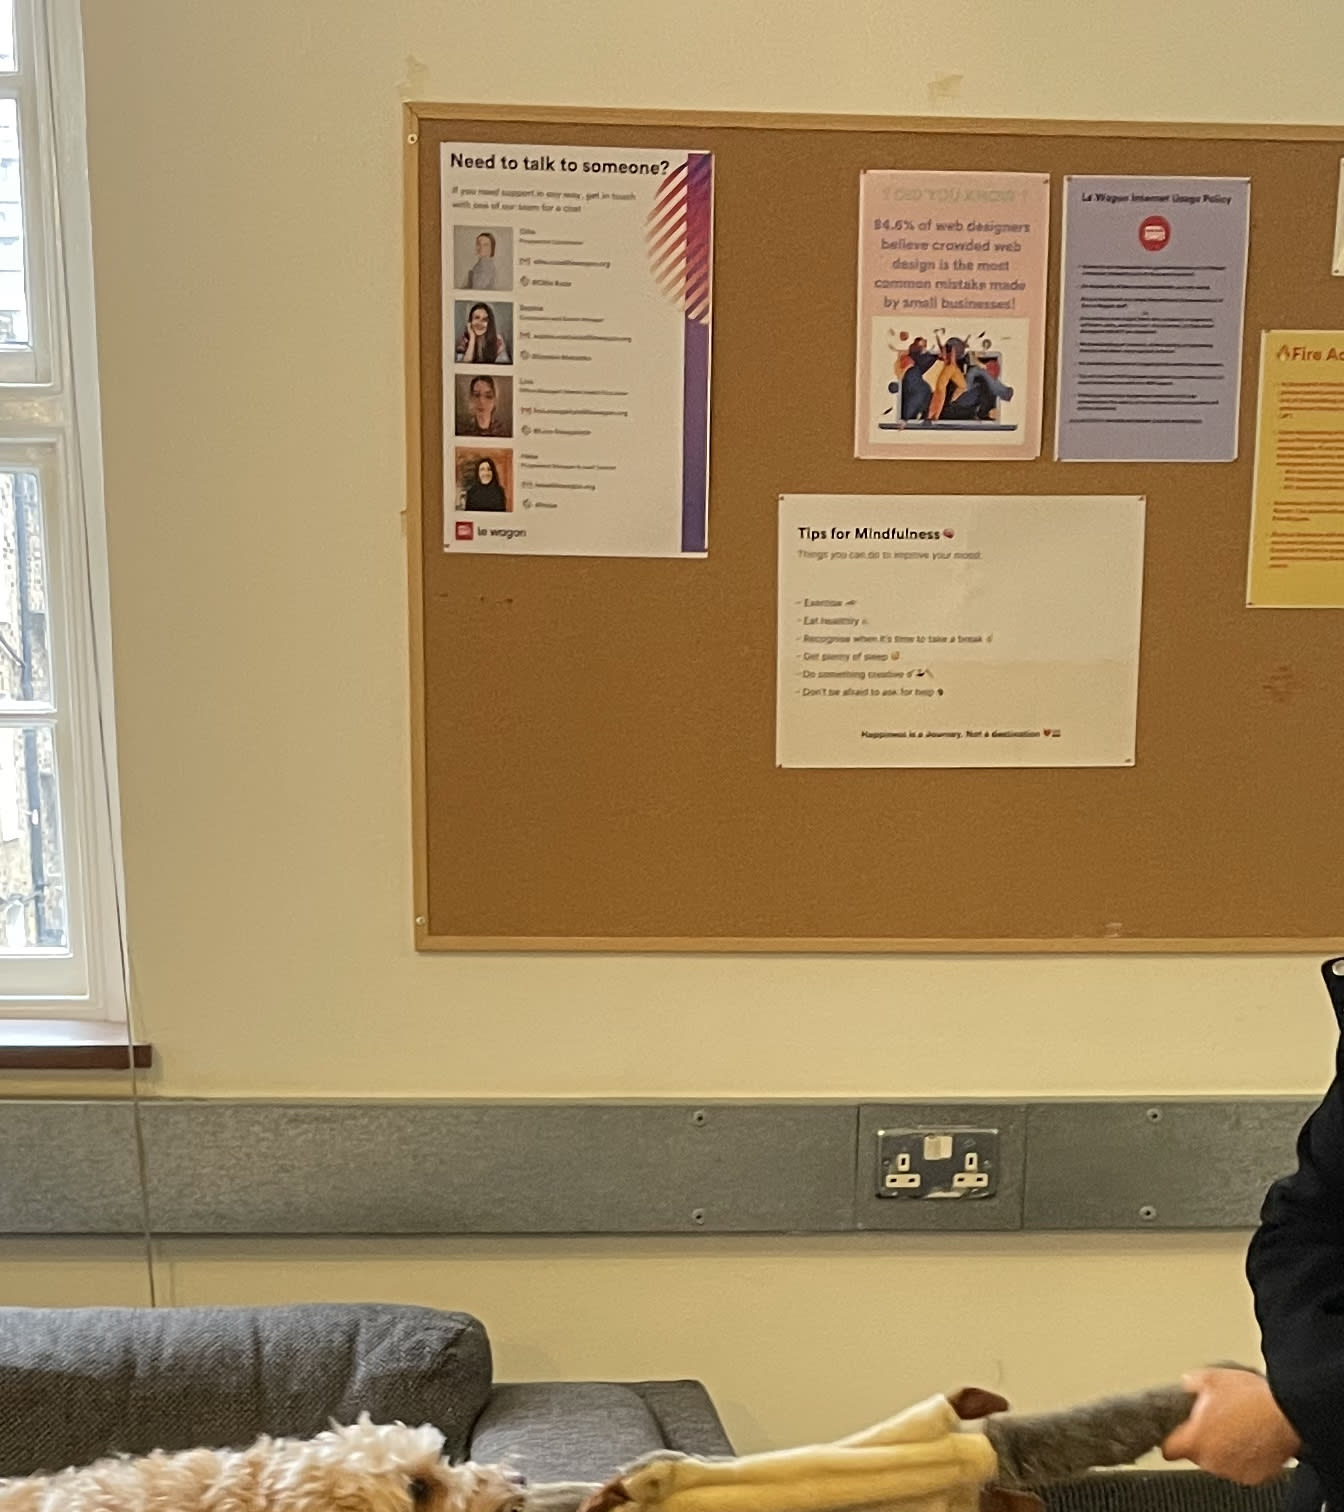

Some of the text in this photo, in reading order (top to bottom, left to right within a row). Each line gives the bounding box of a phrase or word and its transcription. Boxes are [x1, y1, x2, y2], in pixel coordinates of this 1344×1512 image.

[450, 153, 670, 176] Need to talk to someone?
[918, 218, 932, 231] of
[936, 219, 963, 232] web
[967, 221, 1031, 236] designers
[881, 238, 1022, 252] believe crowded web
[892, 258, 1010, 273] design is the most
[874, 279, 1026, 291] common mistake made
[883, 296, 1016, 310] by small businesses!
[1292, 346, 1322, 361] Fire
[490, 528, 527, 540] wagon
[797, 526, 941, 541] Tips for Mindfulness
[797, 549, 829, 560] Things
[830, 551, 847, 560] you
[849, 551, 866, 559] can
[867, 550, 880, 559] do
[882, 550, 892, 559] to
[894, 550, 929, 560] improve
[932, 551, 951, 561] your
